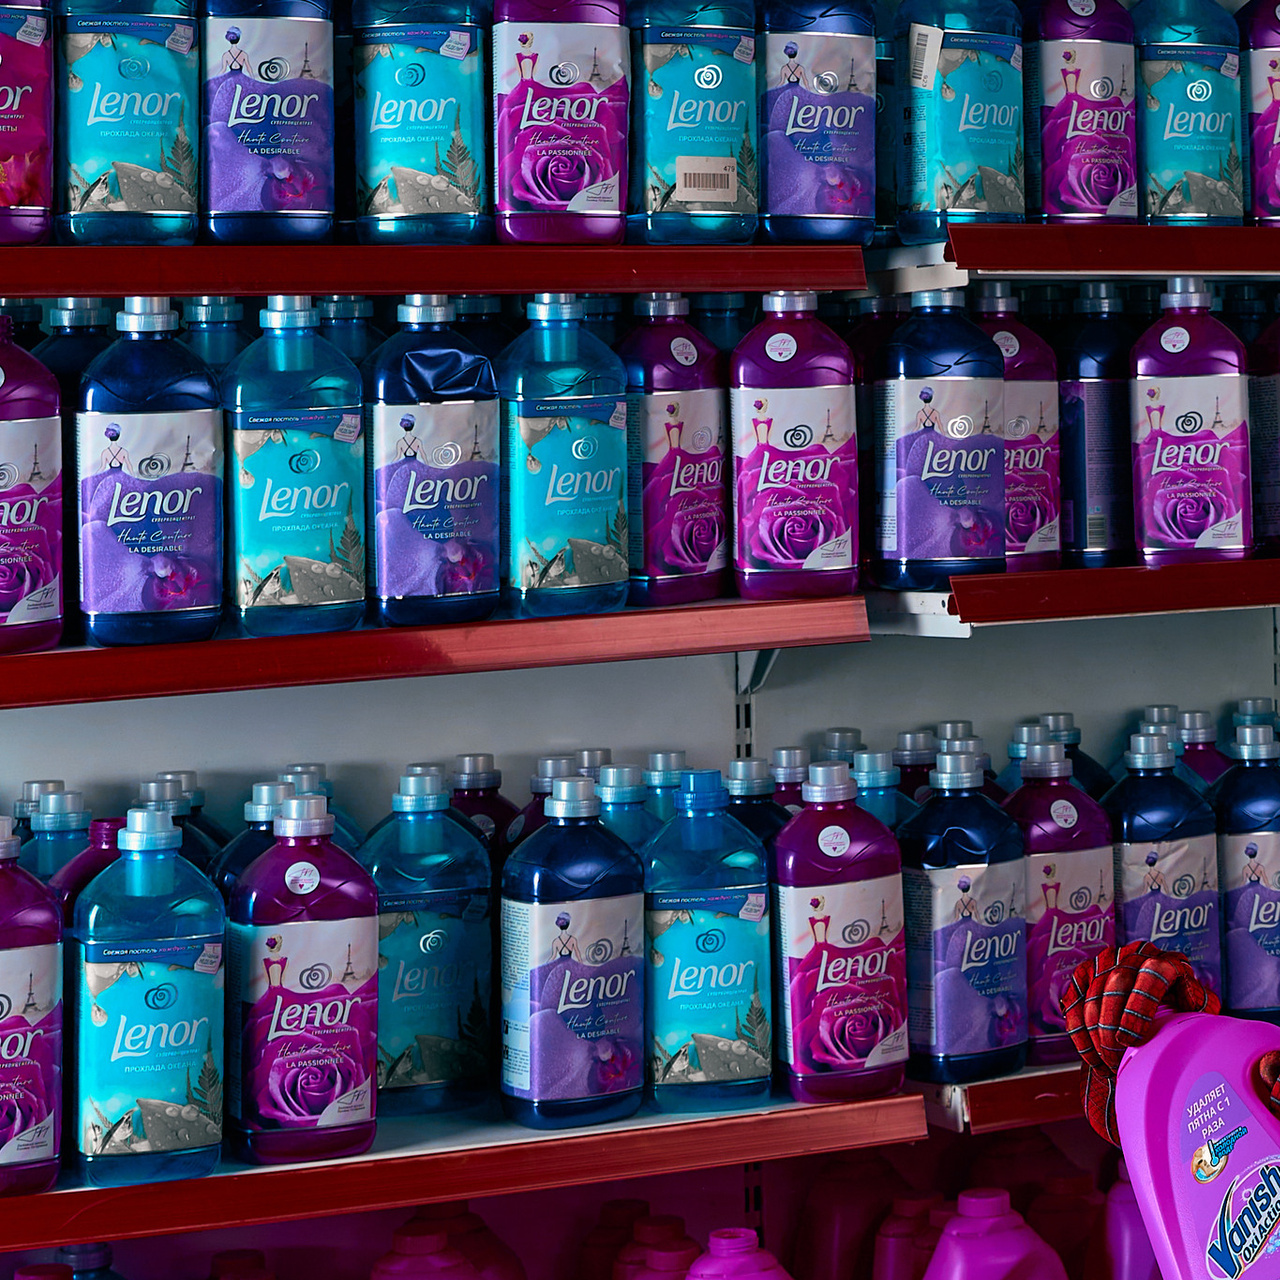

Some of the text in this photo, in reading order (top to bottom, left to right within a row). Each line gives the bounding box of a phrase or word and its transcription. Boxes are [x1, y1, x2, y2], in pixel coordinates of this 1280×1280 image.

[87, 83, 180, 127] Lenor
[228, 84, 318, 128] Lenor
[370, 92, 456, 133] Lenor
[520, 88, 608, 129] Lenor
[667, 90, 745, 132] Lenor
[786, 96, 863, 136] Lenor
[959, 94, 1019, 132] Lenor
[1066, 101, 1131, 139] Lenor
[1163, 103, 1232, 140] Lenor
[670, 457, 724, 495] Lenor
[757, 452, 839, 492] Lenor
[921, 442, 996, 480] Lenor
[1151, 437, 1230, 475] Lenor
[107, 483, 202, 527] Lenor
[259, 479, 348, 522] Lenor
[402, 472, 487, 514] Lenor
[545, 465, 620, 506] Lenor
[140, 545, 182, 553] DESIRABLE
[1048, 915, 1110, 956] Lenor
[1151, 901, 1213, 942] Lenor
[817, 947, 896, 992] Lenor
[961, 929, 1020, 971] Lenor
[557, 969, 635, 1014] Lenor
[668, 958, 753, 1001] Lenor
[268, 996, 361, 1040] Lenor
[680, 1000, 744, 1011] ПРОХЛАДА ОКЕАНА
[110, 1015, 208, 1062] Lenor
[586, 1028, 620, 1038] DESIRABLE
[125, 1061, 196, 1073] ПРОХЛАДА ОКЕАНА
[1187, 1084, 1225, 1118] УДАЛЯЕТ
[1188, 1097, 1230, 1133] ПЯТНА С 1
[1202, 1118, 1225, 1139] РАЗА
[1243, 1232, 1259, 1262] Oxi
